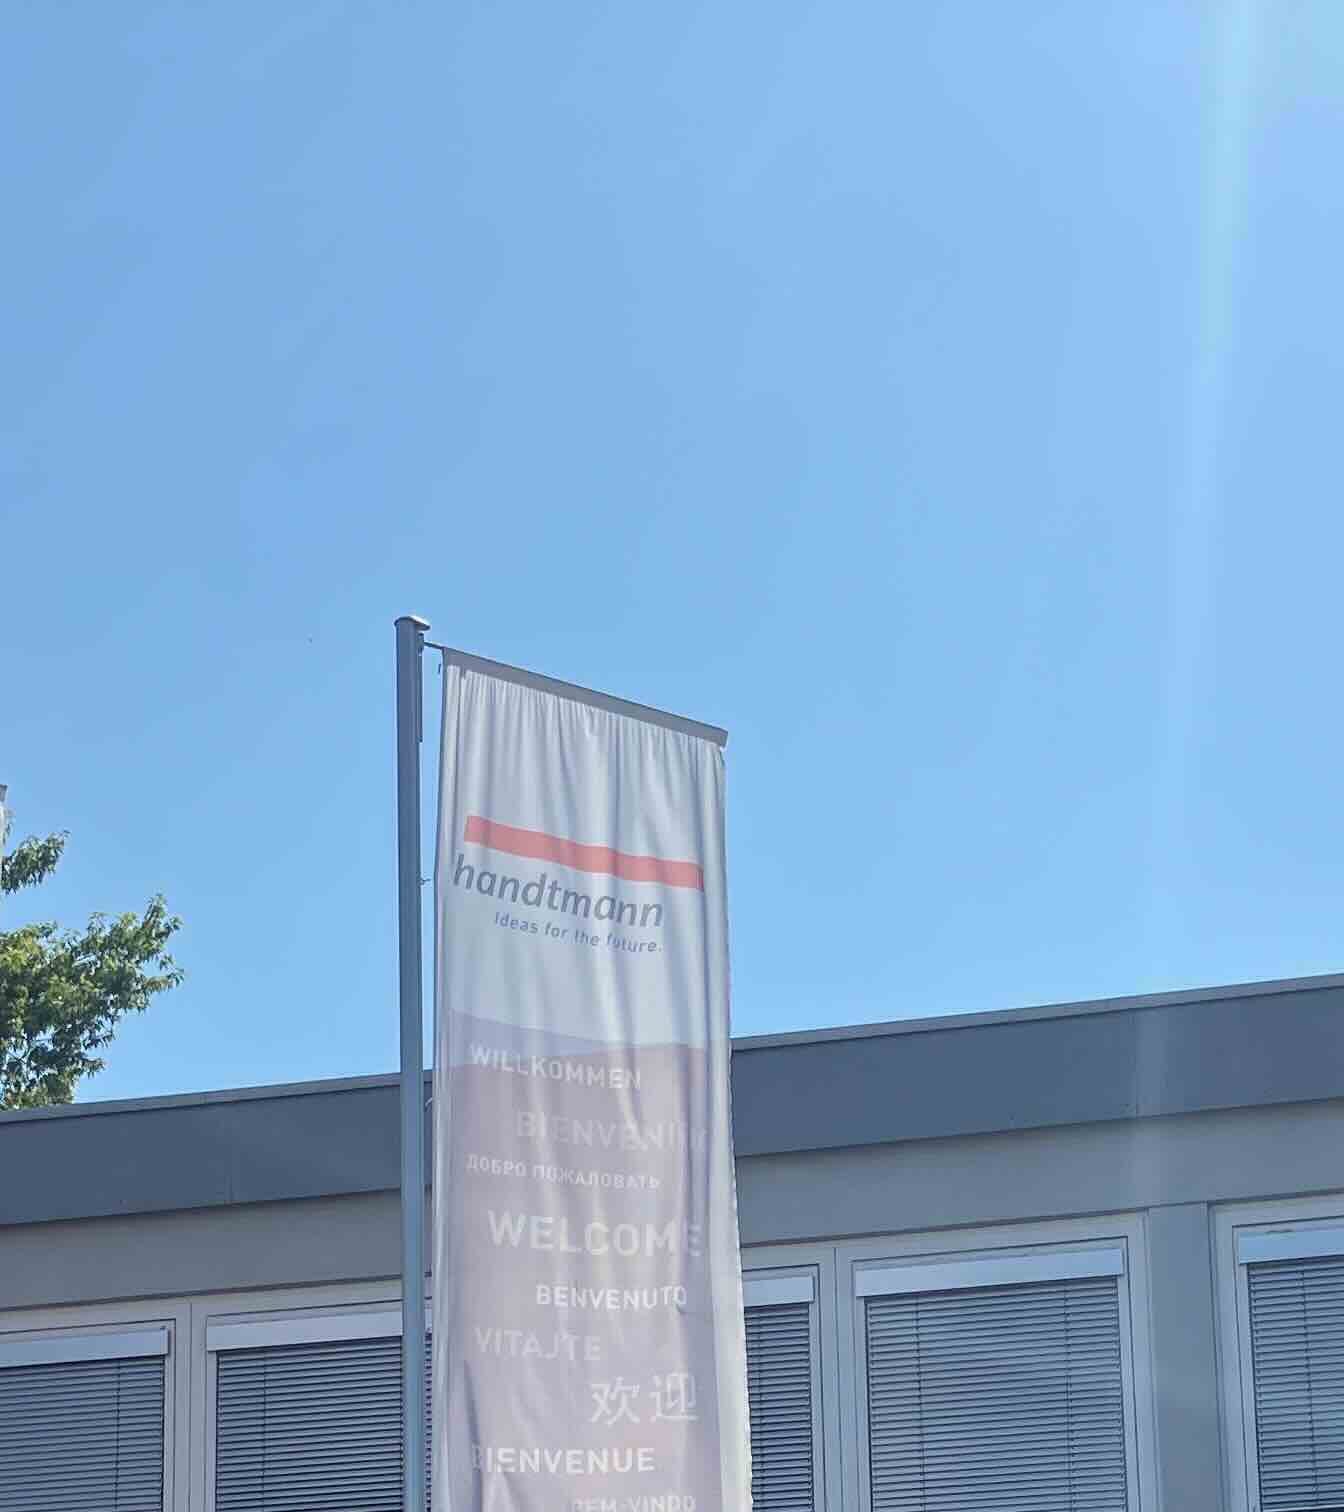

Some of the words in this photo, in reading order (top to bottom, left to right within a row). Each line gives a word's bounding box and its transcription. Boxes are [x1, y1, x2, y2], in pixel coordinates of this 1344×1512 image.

[452, 853, 665, 928] handtmann
[495, 911, 539, 935] Ideas
[544, 920, 567, 940] for
[574, 929, 600, 947] the
[604, 933, 664, 954] future.
[468, 1042, 641, 1089] WILLKOMMEN
[466, 1153, 527, 1177] ДОБРО
[487, 1208, 703, 1257] WELCOME
[535, 1283, 689, 1312] BENVENUTO
[589, 1373, 698, 1425] 欢迎
